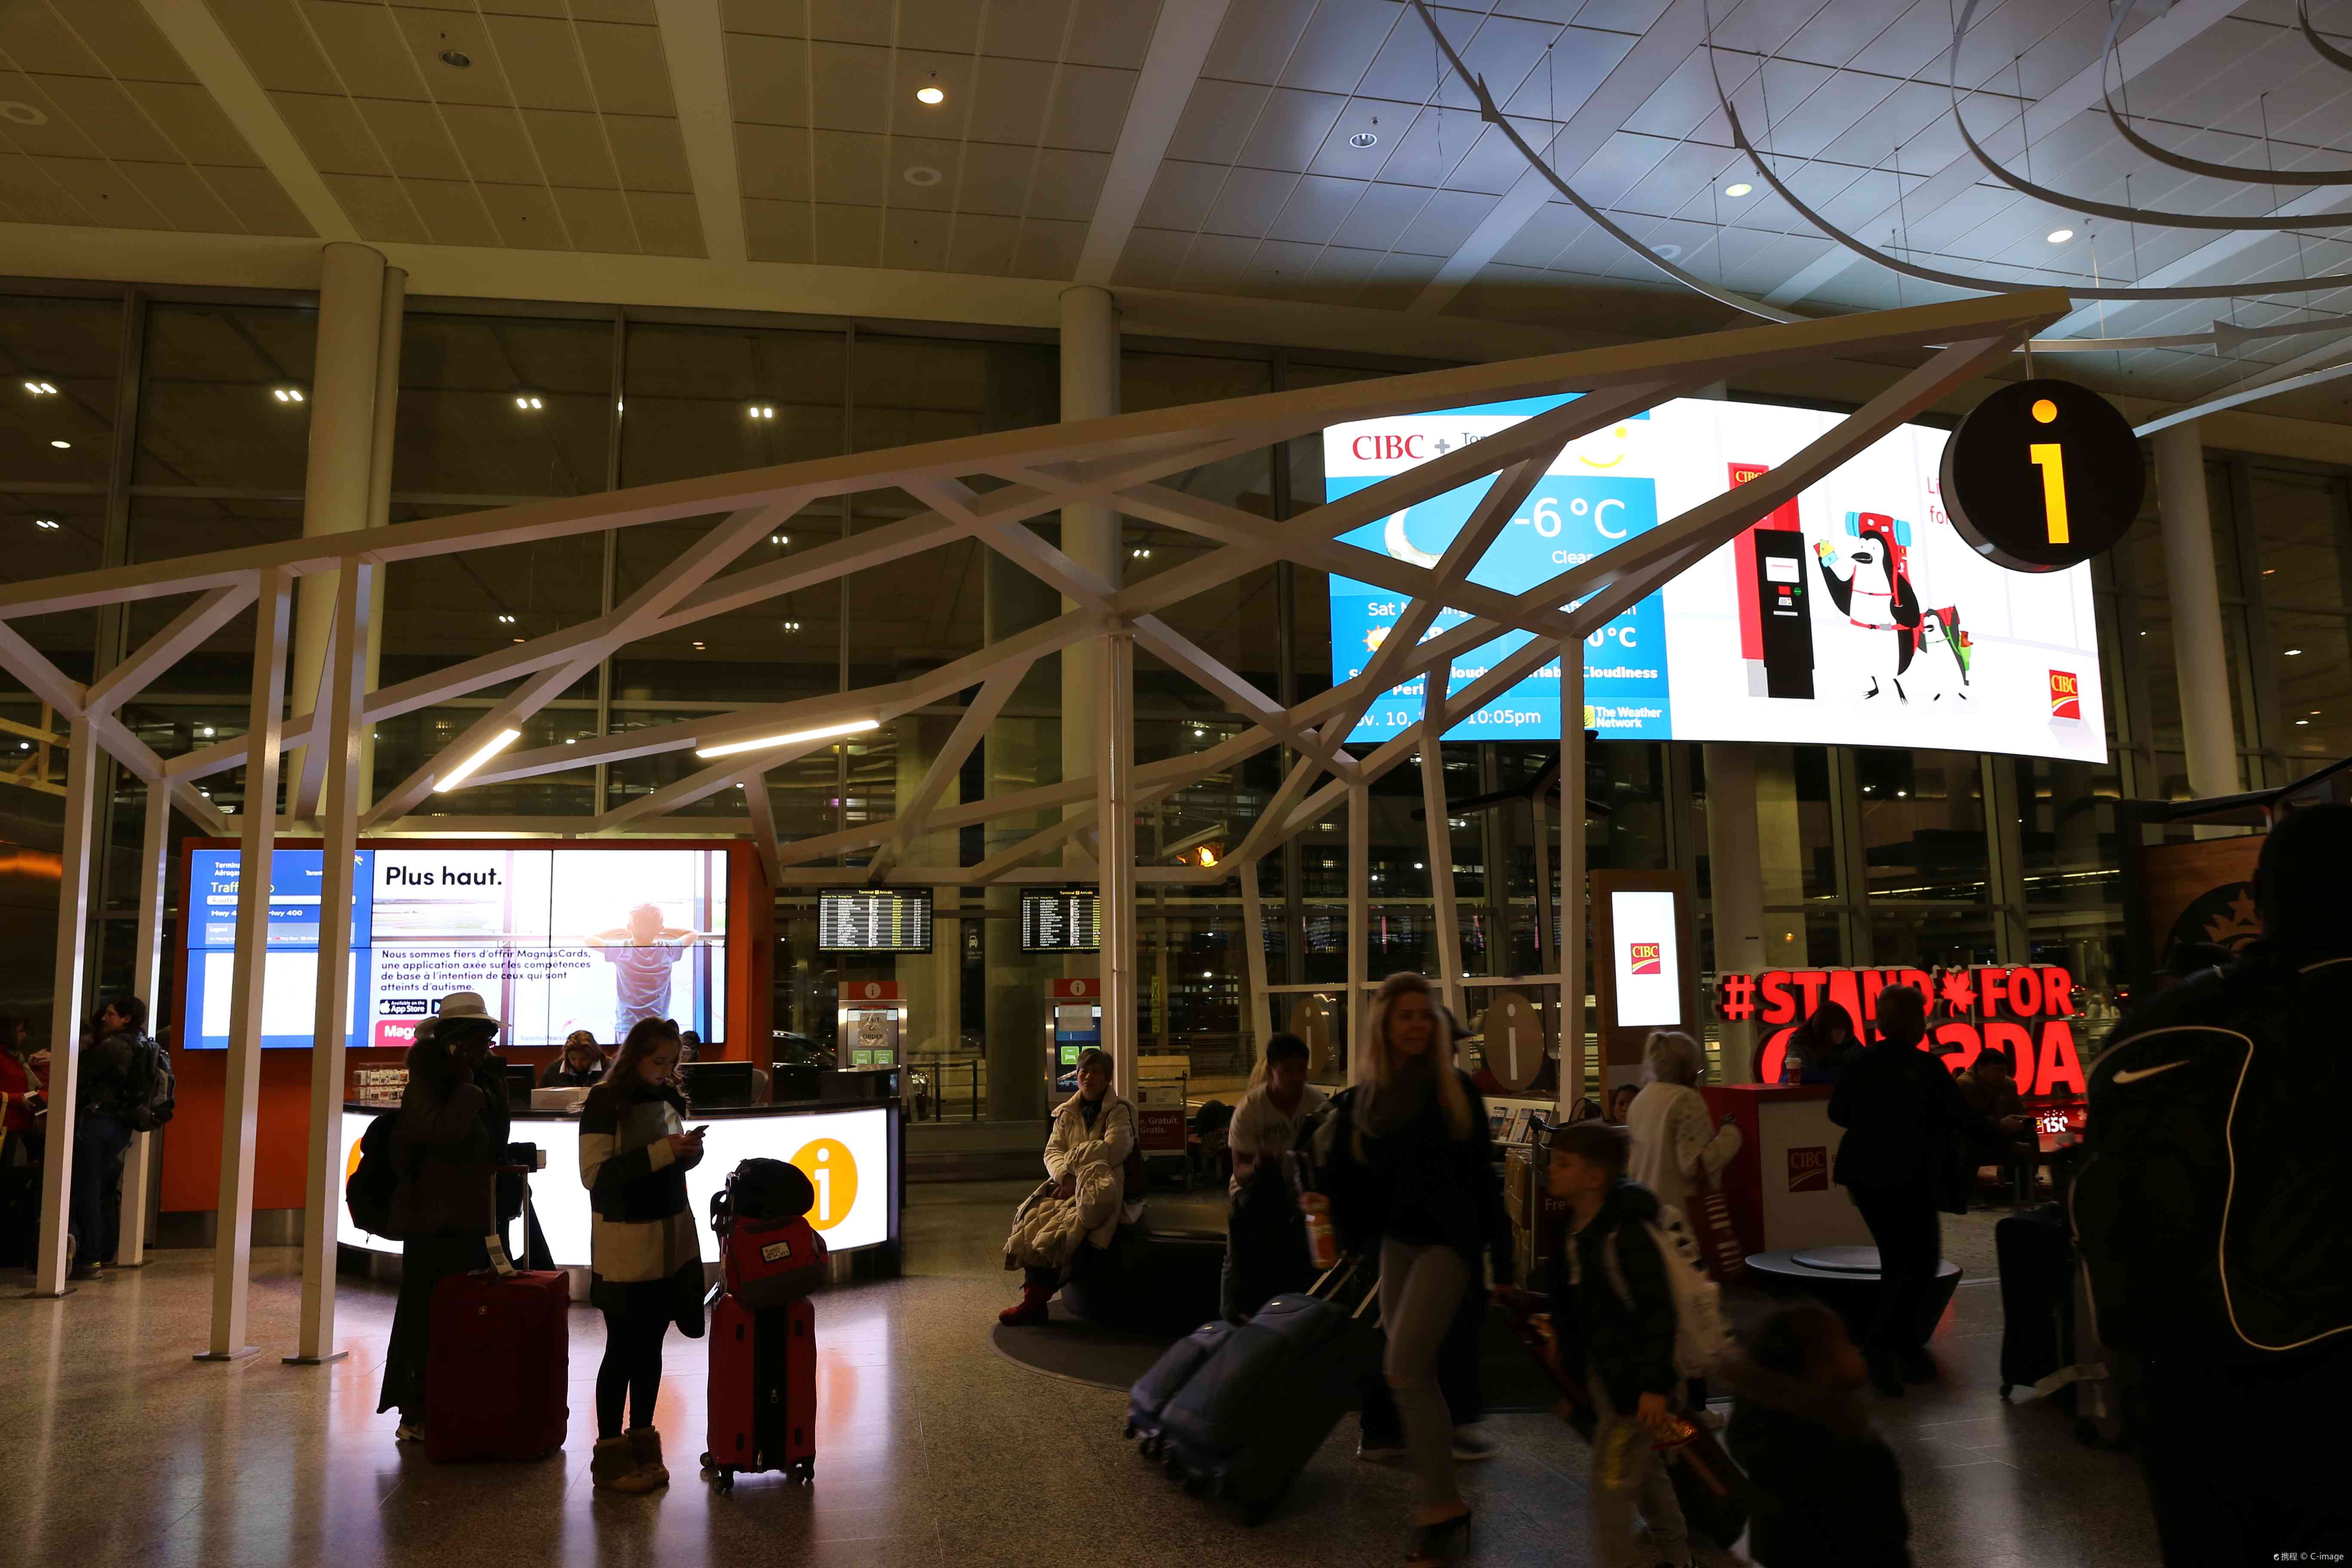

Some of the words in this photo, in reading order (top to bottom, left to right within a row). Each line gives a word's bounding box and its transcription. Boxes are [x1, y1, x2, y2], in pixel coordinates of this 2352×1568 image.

[1352, 435, 1424, 460] CIBC
[1514, 497, 1627, 539] -6°C
[1552, 550, 1594, 564] Clear
[1368, 602, 1396, 616] Sat
[2051, 674, 2077, 694] CIBC
[1386, 711, 1412, 727] 10,
[1468, 709, 1541, 727] 10:05pm
[1595, 707, 1616, 717] The
[1617, 707, 1662, 718] Weather
[1596, 717, 1643, 728] Network
[386, 866, 434, 885] Plus
[442, 866, 502, 885] haut.
[211, 882, 239, 893] Traff
[454, 949, 476, 958] fiers
[517, 949, 591, 959] MagnusCards,
[1632, 946, 1658, 958] CIBC
[403, 960, 459, 971] application
[508, 960, 521, 968] les
[524, 960, 591, 970] compétences
[486, 971, 498, 980] de
[527, 971, 542, 981] qui
[1981, 967, 2075, 1017] FOR
[391, 1005, 406, 1014] App
[1148, 1116, 1180, 1125] Gratuit.
[1790, 1152, 1825, 1168] CIBC
